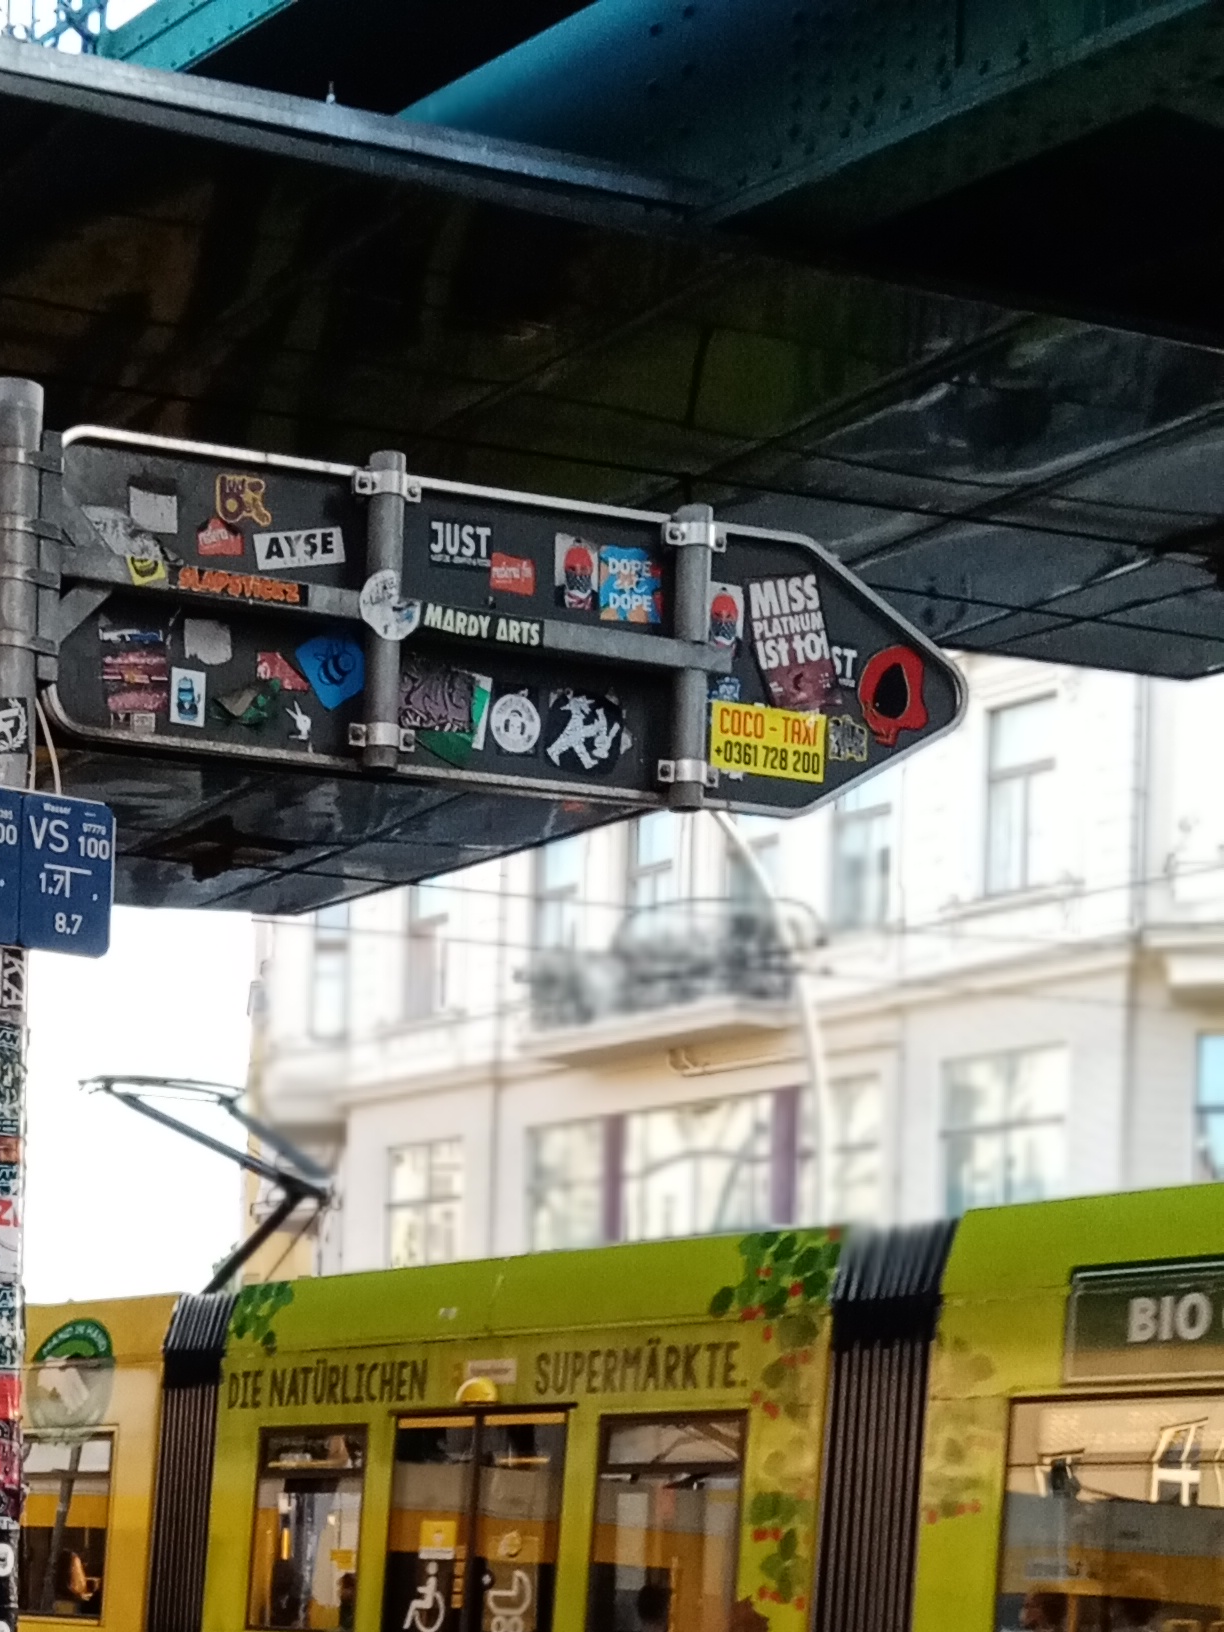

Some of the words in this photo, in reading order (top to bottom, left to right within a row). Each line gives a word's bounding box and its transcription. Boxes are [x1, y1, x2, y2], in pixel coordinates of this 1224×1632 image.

[430, 521, 491, 558] JUST
[608, 557, 652, 577] DOPE
[609, 593, 652, 612] DOPE
[749, 574, 820, 619] MISS
[423, 603, 491, 638] MARDY
[496, 618, 541, 646] ARTS
[752, 611, 826, 641] PLATNUM
[719, 707, 765, 740] COCO
[782, 716, 819, 747] TAXI
[762, 746, 788, 771] 728
[792, 750, 821, 775] 200
[42, 802, 72, 815] Wasser
[29, 815, 69, 853] VS
[78, 836, 110, 861] 100
[39, 873, 64, 895] 1.7
[54, 912, 83, 935] 8.7
[1127, 1292, 1213, 1343] BIO
[227, 1370, 263, 1410] DIE
[269, 1358, 428, 1407] NATÜRLICHEN
[535, 1336, 748, 1396] SUPERMÄRKTE.
